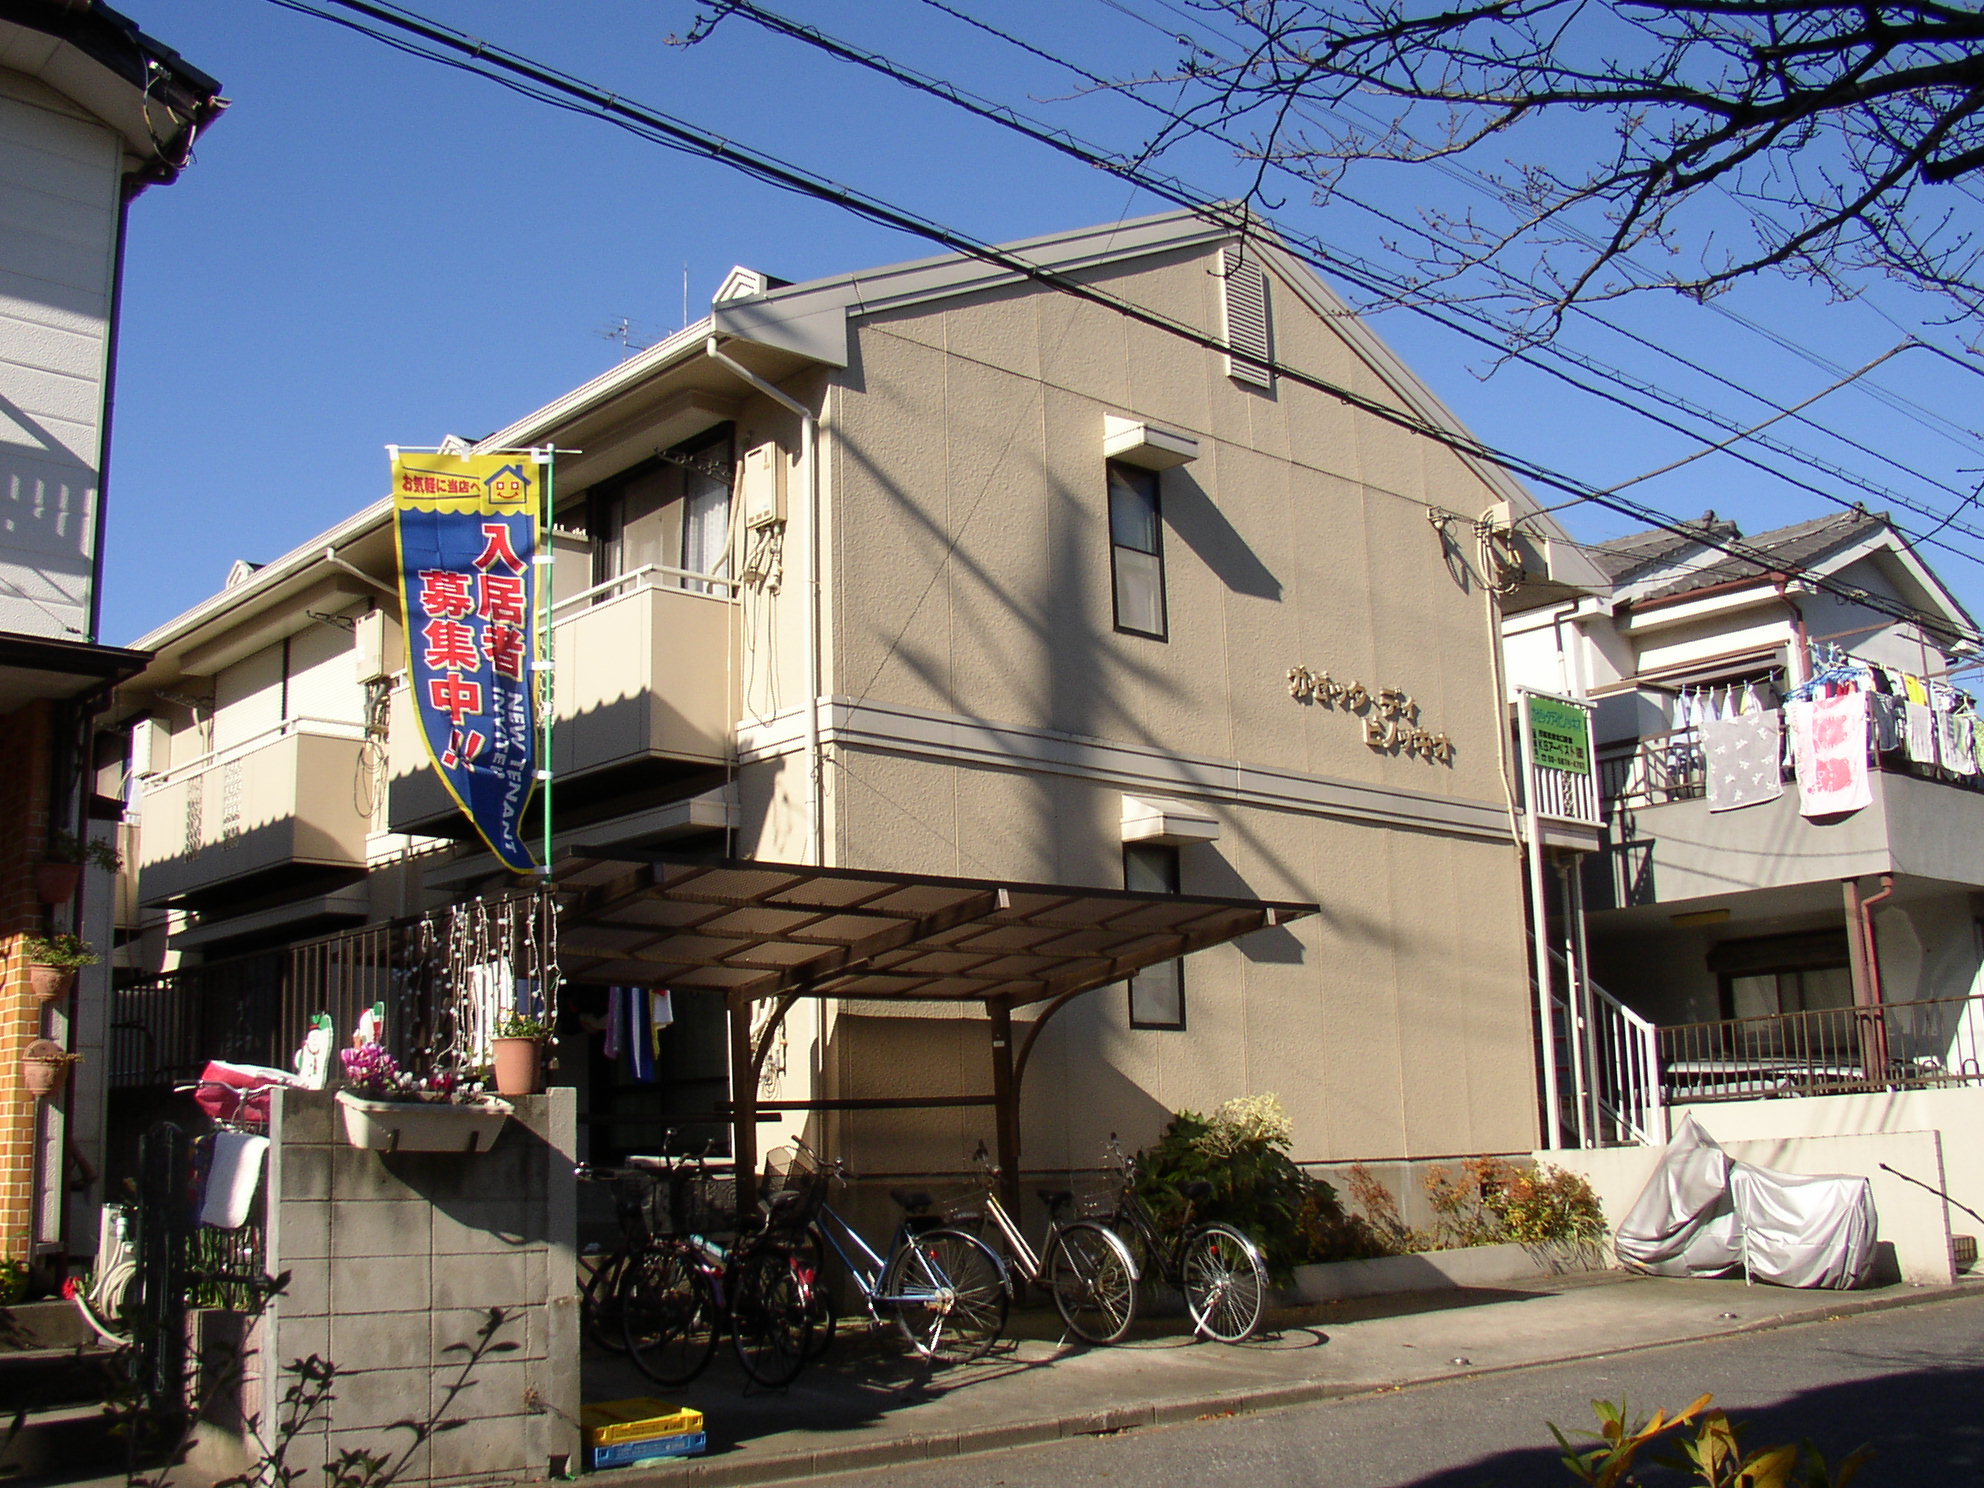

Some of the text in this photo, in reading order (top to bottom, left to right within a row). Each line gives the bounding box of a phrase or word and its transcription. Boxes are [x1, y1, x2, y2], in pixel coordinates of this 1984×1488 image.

[402, 473, 481, 495] お気軽に当店へ
[473, 522, 528, 684] 入居者
[502, 692, 527, 854] NEW TENANT
